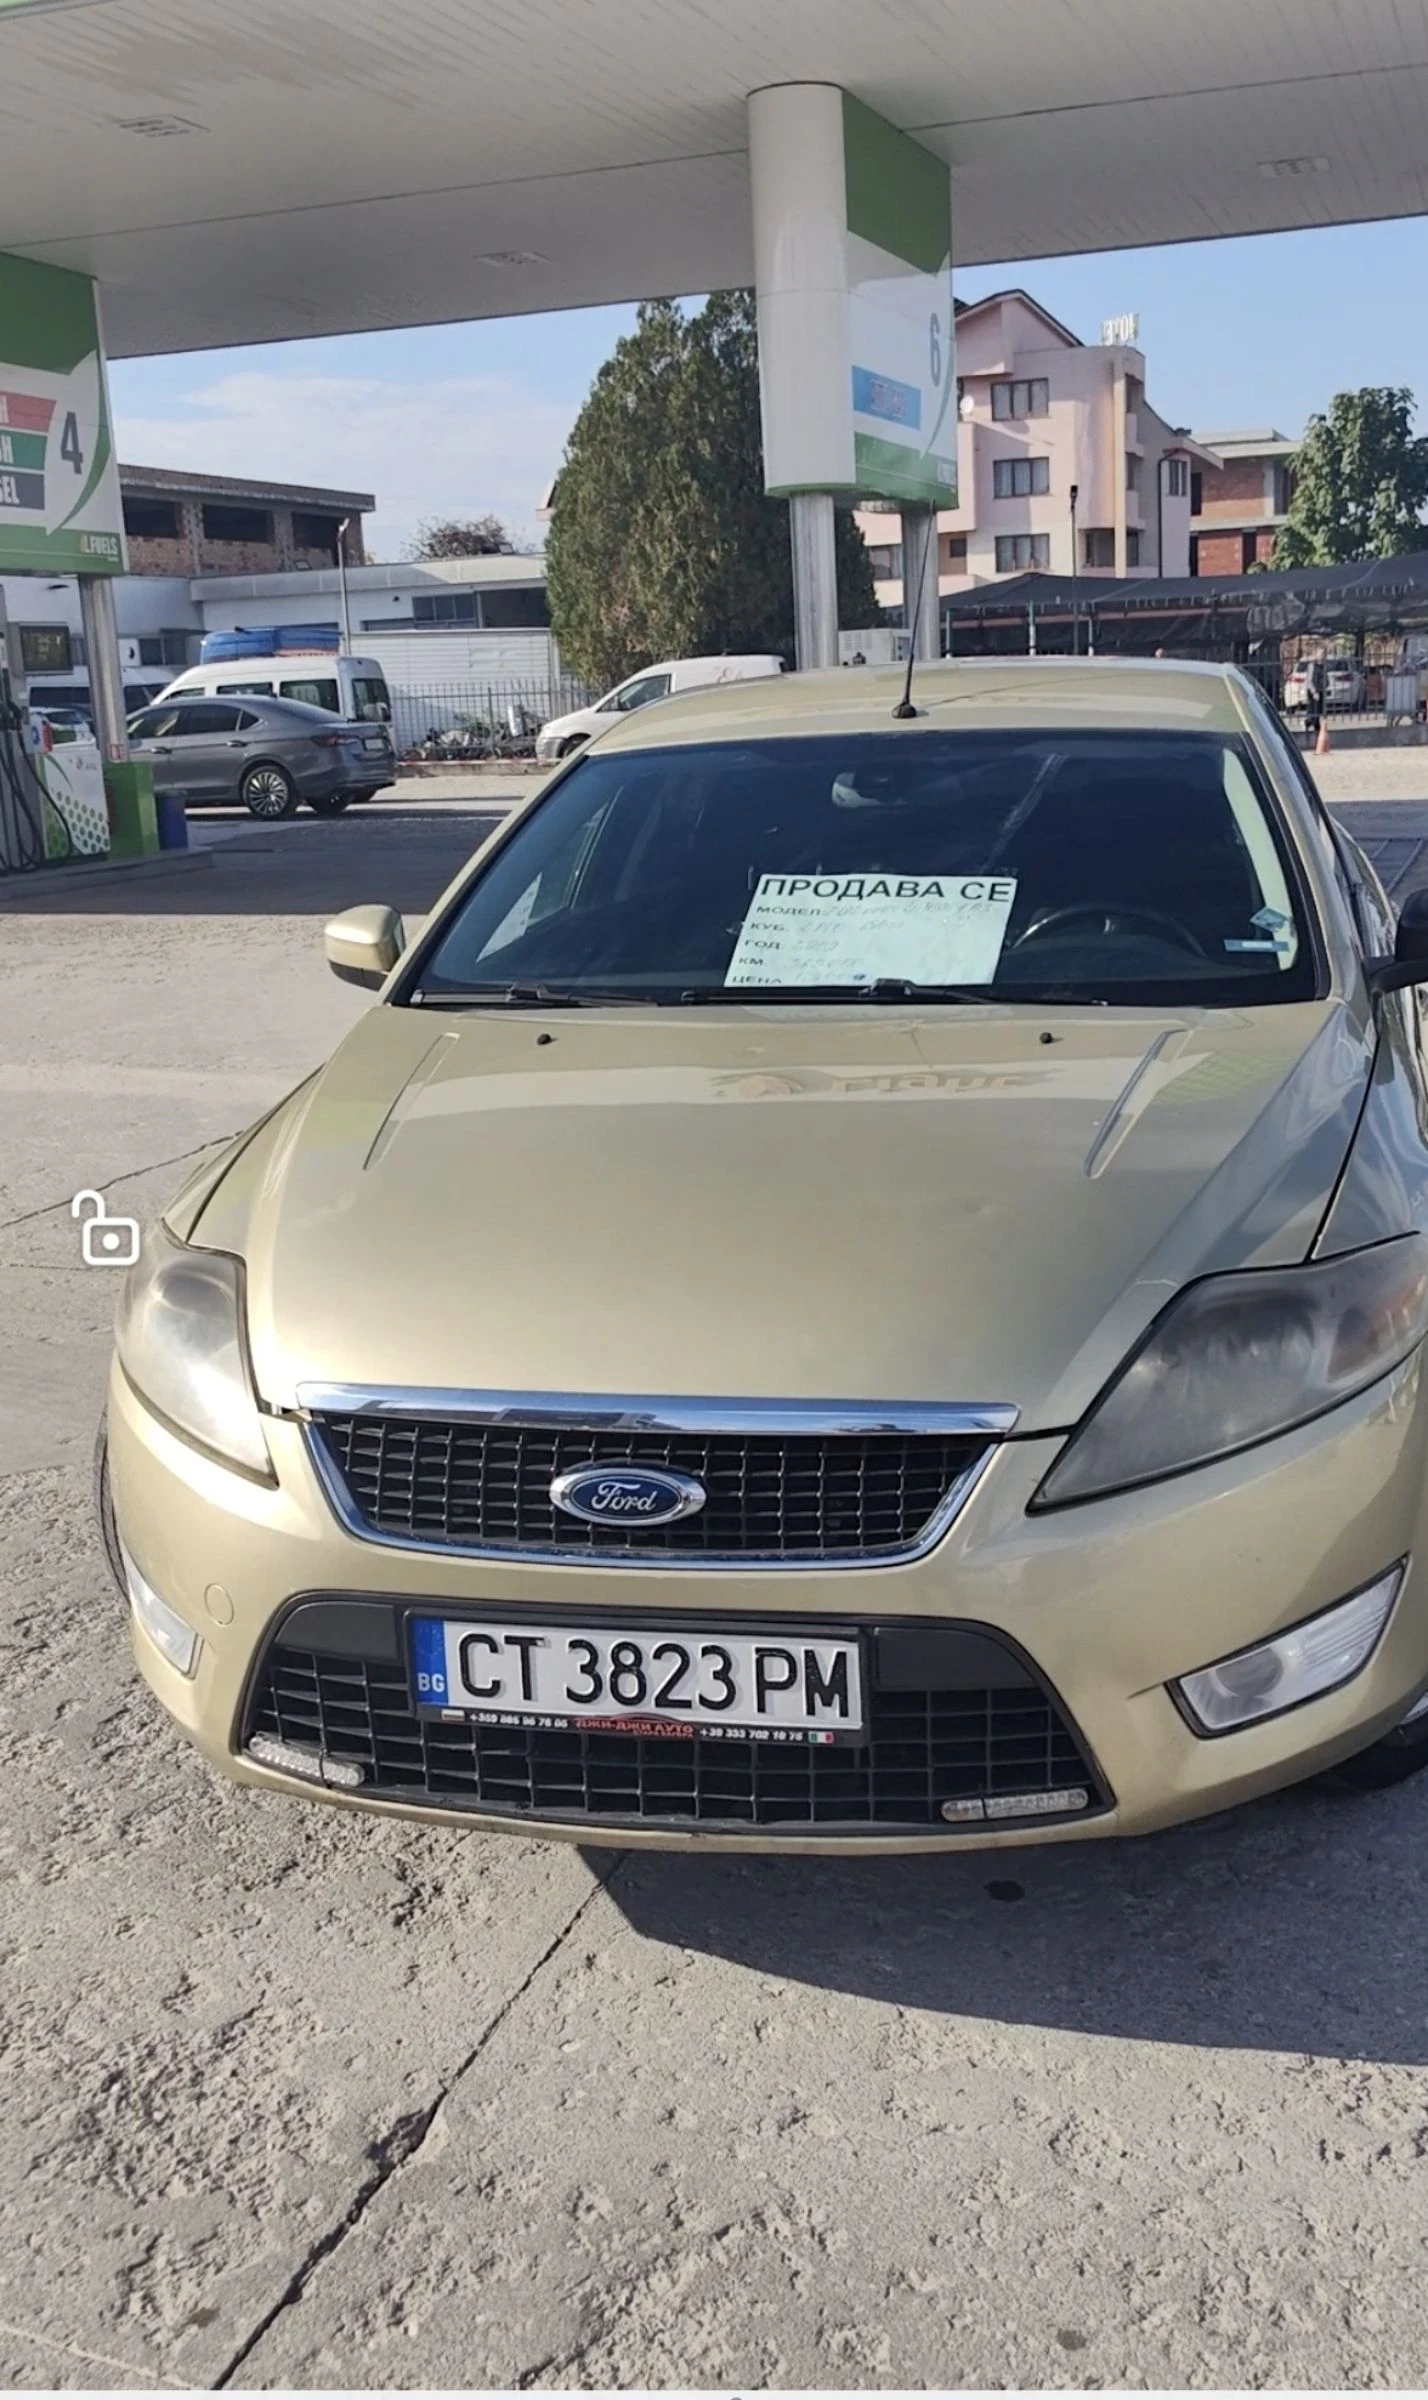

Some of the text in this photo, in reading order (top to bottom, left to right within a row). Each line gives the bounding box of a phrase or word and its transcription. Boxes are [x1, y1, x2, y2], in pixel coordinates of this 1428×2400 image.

[930, 312, 941, 387] 6
[60, 411, 84, 475] 4
[761, 878, 1013, 903] ПРОДАВА СЕ
[591, 1481, 658, 1511] Ford
[418, 1672, 446, 1694] BG
[459, 1633, 849, 1719] CT 3823 PM
[470, 1712, 498, 1724] +359
